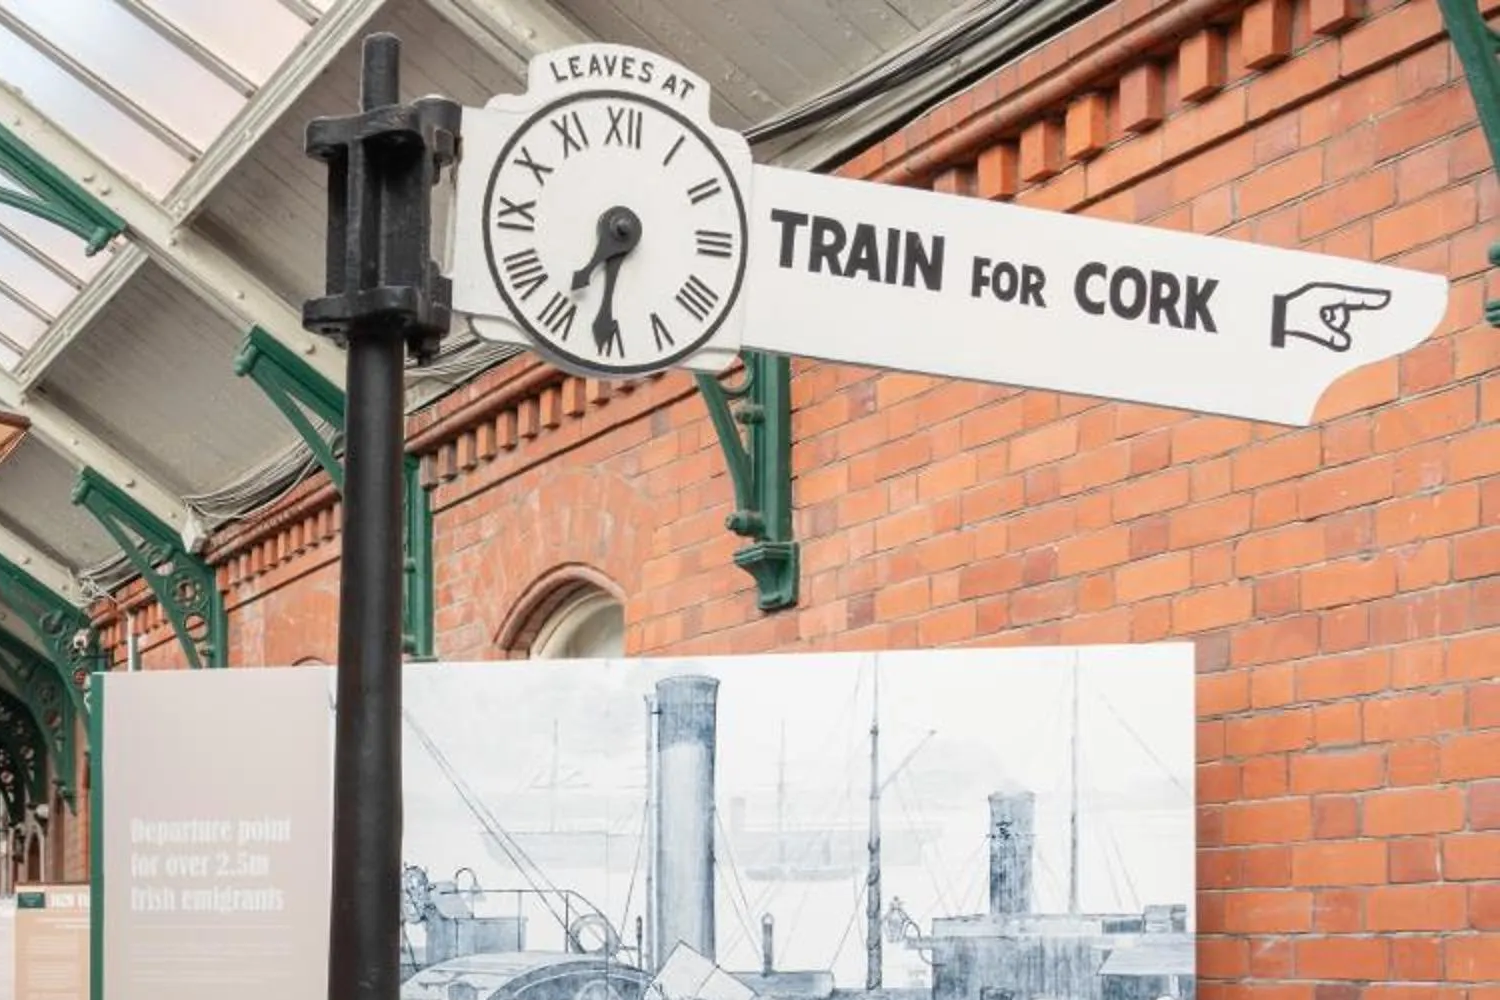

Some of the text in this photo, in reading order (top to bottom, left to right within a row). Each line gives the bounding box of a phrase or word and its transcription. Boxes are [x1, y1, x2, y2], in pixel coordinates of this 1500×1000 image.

[549, 54, 696, 100] LEAVES AT
[551, 111, 589, 159] XI
[605, 106, 643, 149] XII
[513, 146, 554, 186] X
[662, 135, 686, 167] I
[687, 177, 722, 205] II
[695, 229, 733, 258] III
[770, 208, 1220, 333] TRAIN FOR CORK
[649, 312, 675, 352] V
[237, 815, 292, 845] point
[131, 852, 158, 877] for
[164, 854, 210, 877] over
[131, 884, 285, 914] Irish emigrants
